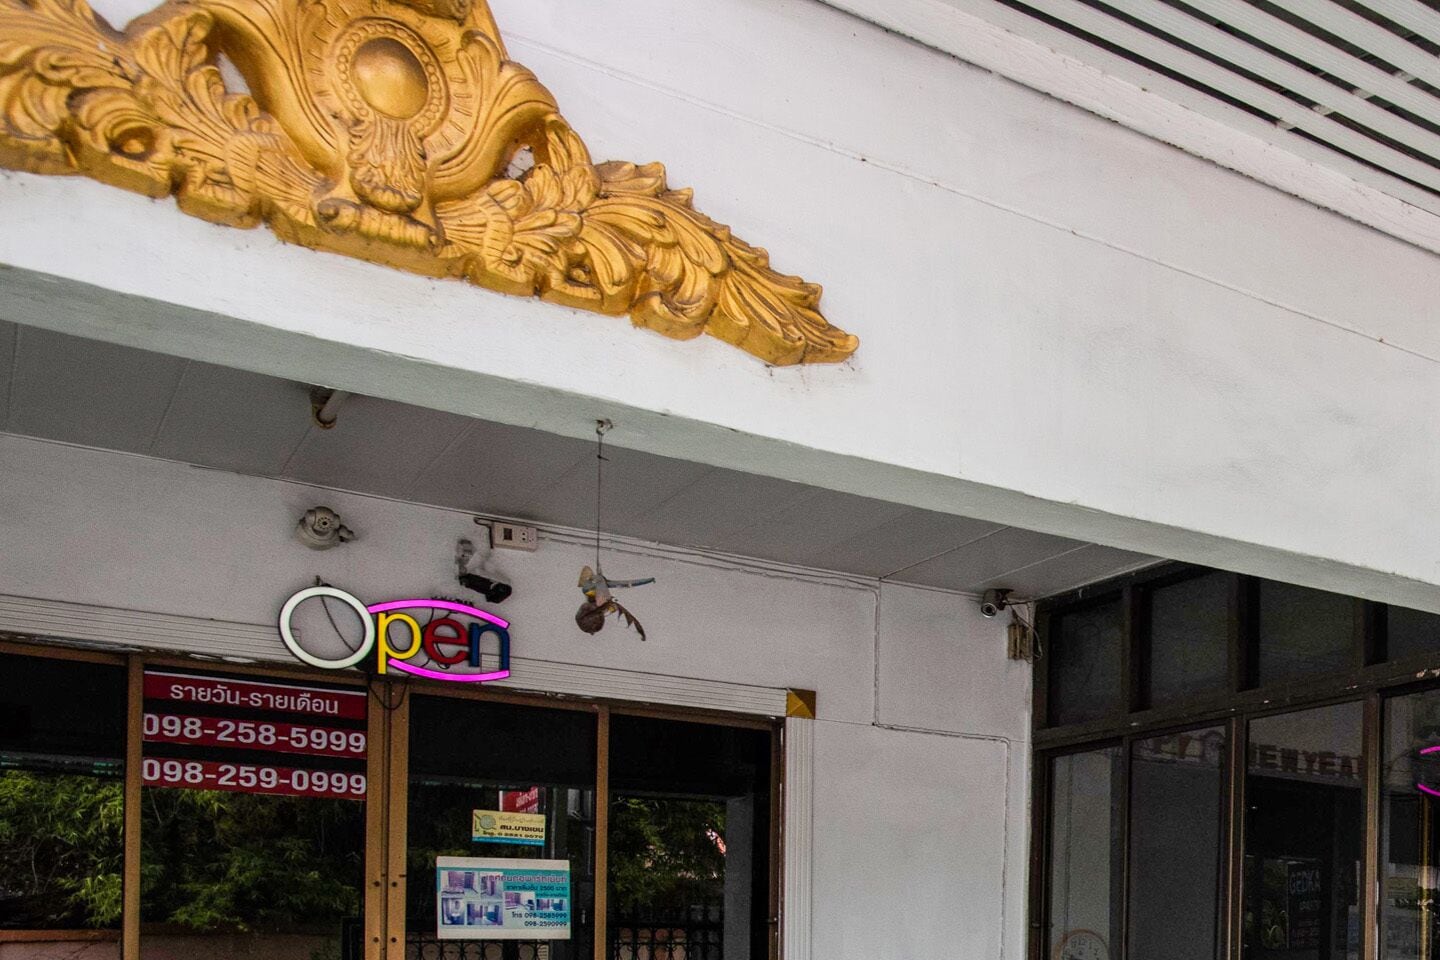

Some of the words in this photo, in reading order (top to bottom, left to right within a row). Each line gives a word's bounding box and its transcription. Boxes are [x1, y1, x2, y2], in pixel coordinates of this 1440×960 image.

[279, 586, 511, 674] Open
[170, 684, 339, 714] รายวัน-รายเดือน
[143, 713, 366, 752] 098-258-5999
[142, 759, 366, 794] 098-259-0999
